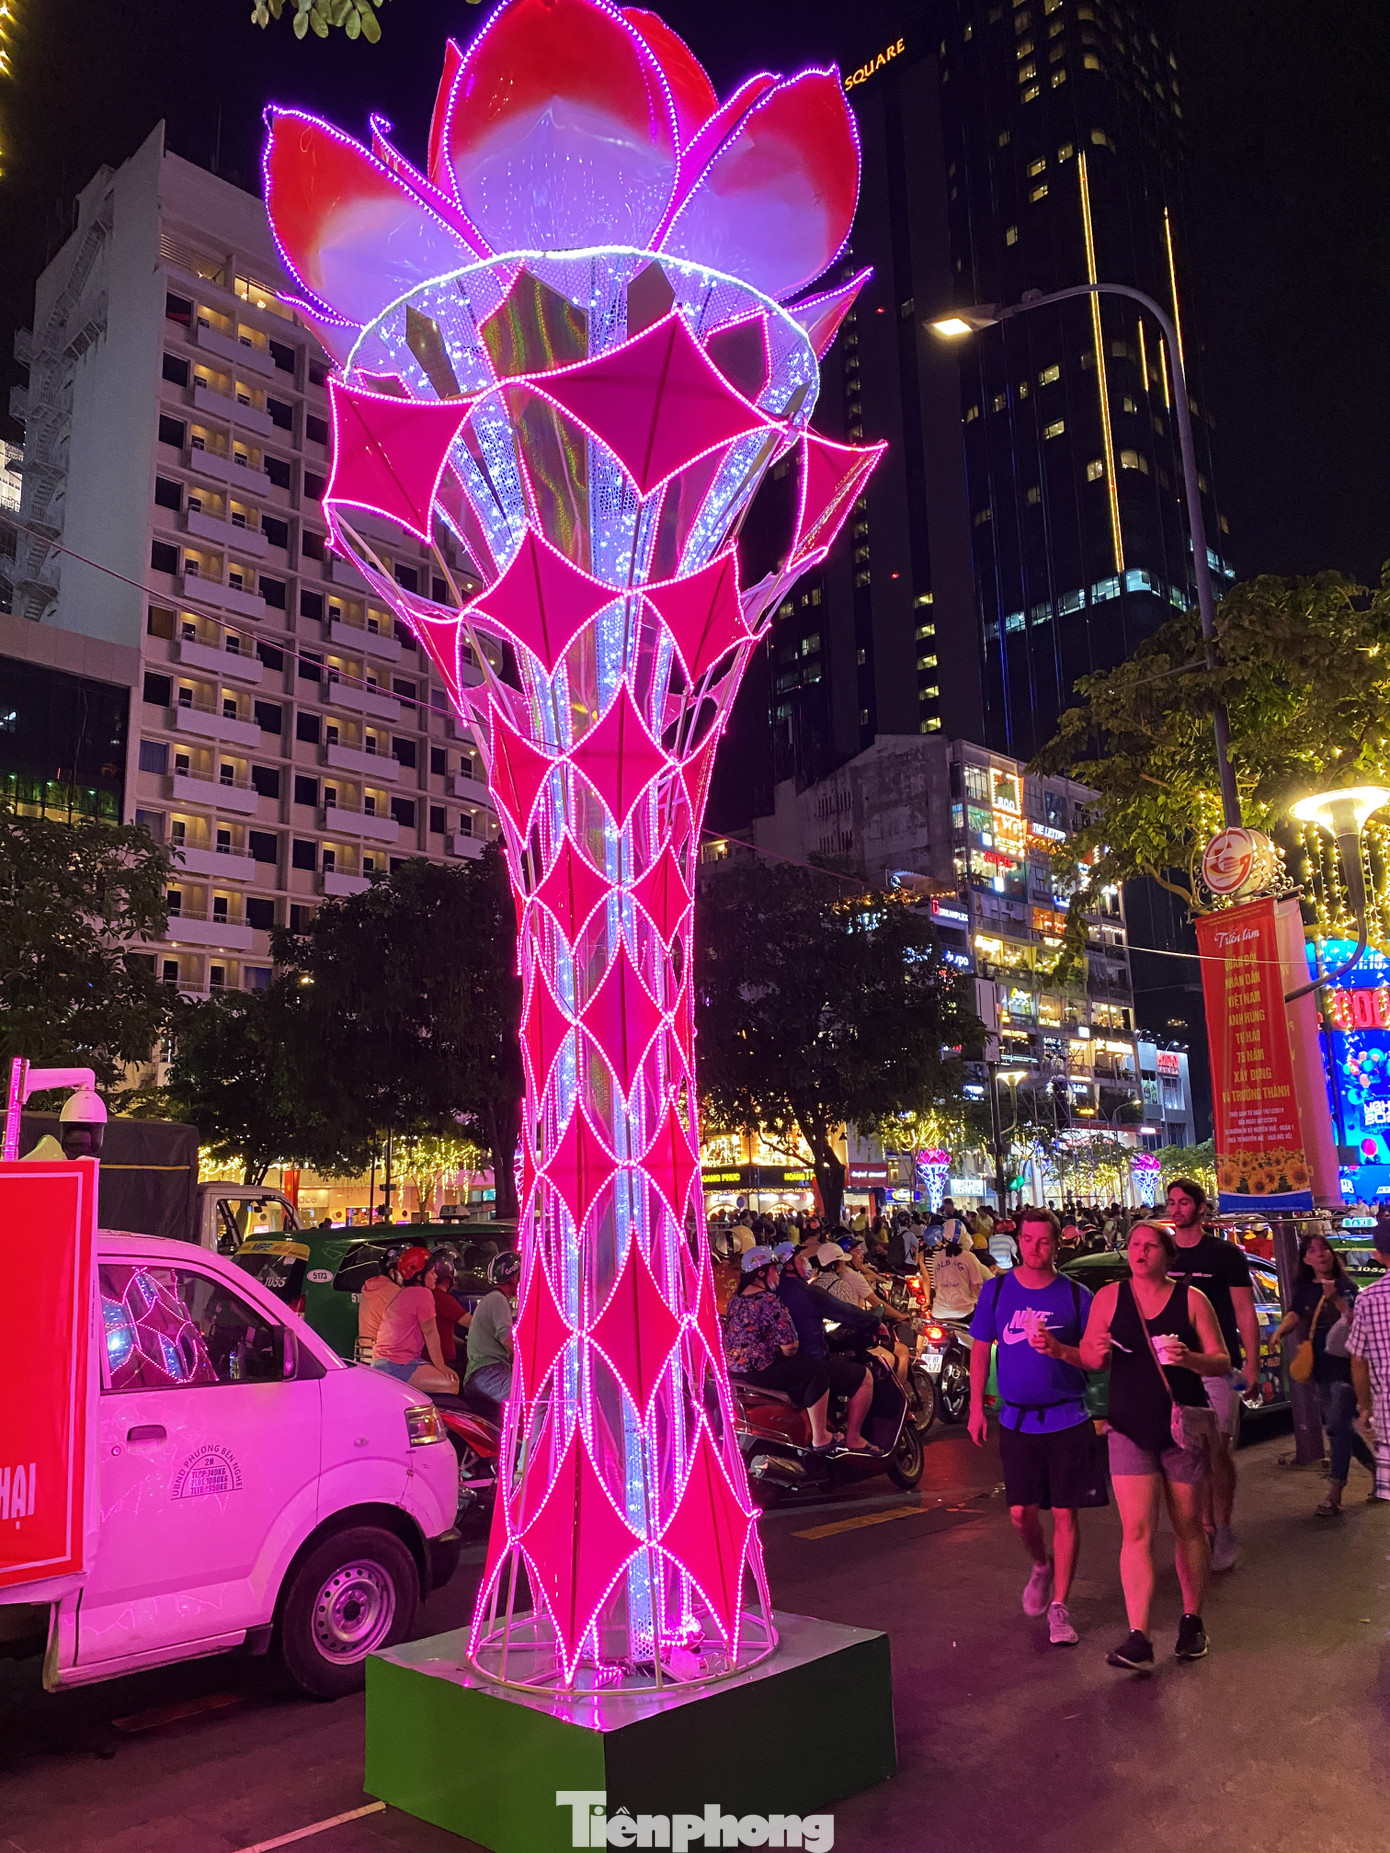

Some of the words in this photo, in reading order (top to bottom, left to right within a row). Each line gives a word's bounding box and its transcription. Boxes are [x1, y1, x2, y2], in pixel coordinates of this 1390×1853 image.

[845, 38, 905, 91] SQUARE
[1237, 1051, 1245, 1063] 75
[312, 1271, 328, 1280] 5173
[264, 1276, 288, 1288] 1055
[172, 1468, 186, 1497] UBND
